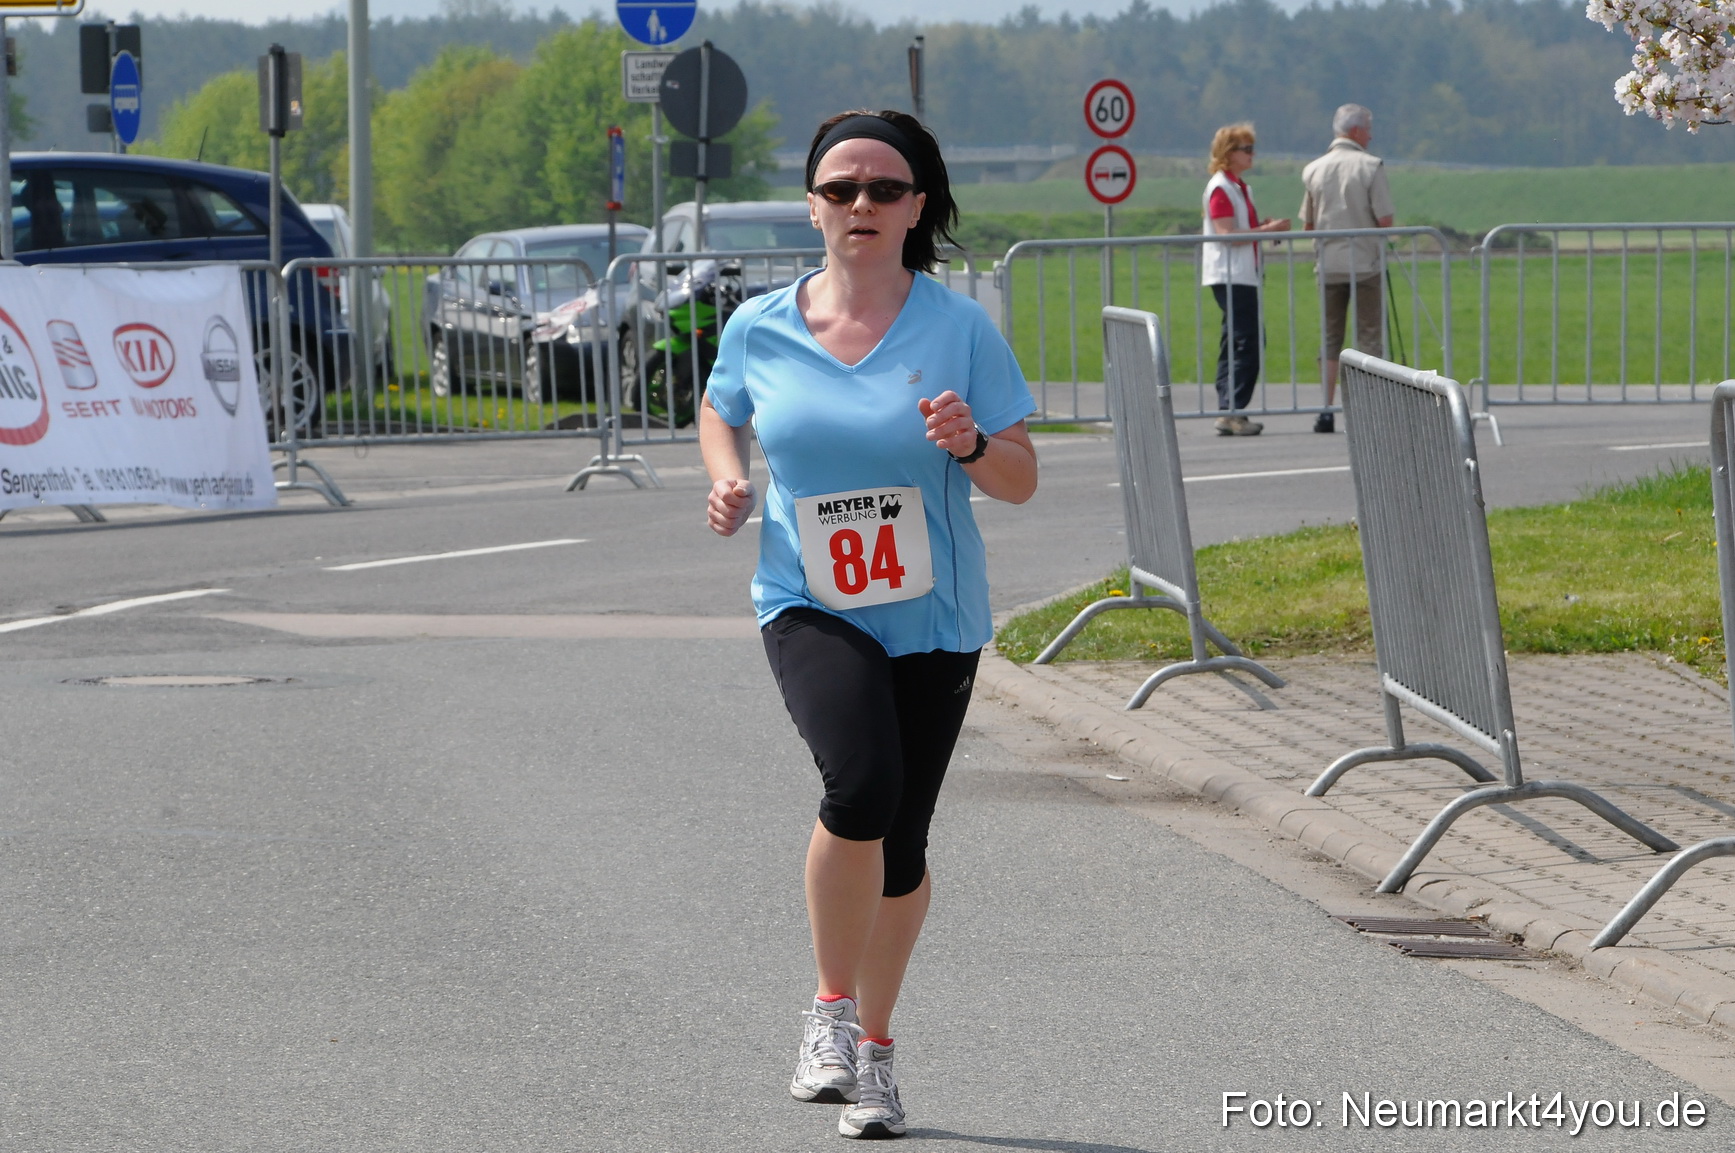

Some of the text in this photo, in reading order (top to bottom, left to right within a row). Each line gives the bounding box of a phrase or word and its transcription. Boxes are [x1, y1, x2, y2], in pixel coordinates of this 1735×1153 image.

[1095, 95, 1124, 122] 60
[117, 338, 166, 373] KIA
[0, 364, 38, 401] NIG
[61, 399, 122, 418] SEAT
[817, 496, 876, 516] MEYER
[818, 509, 878, 526] WERBUNG
[828, 523, 906, 596] 84
